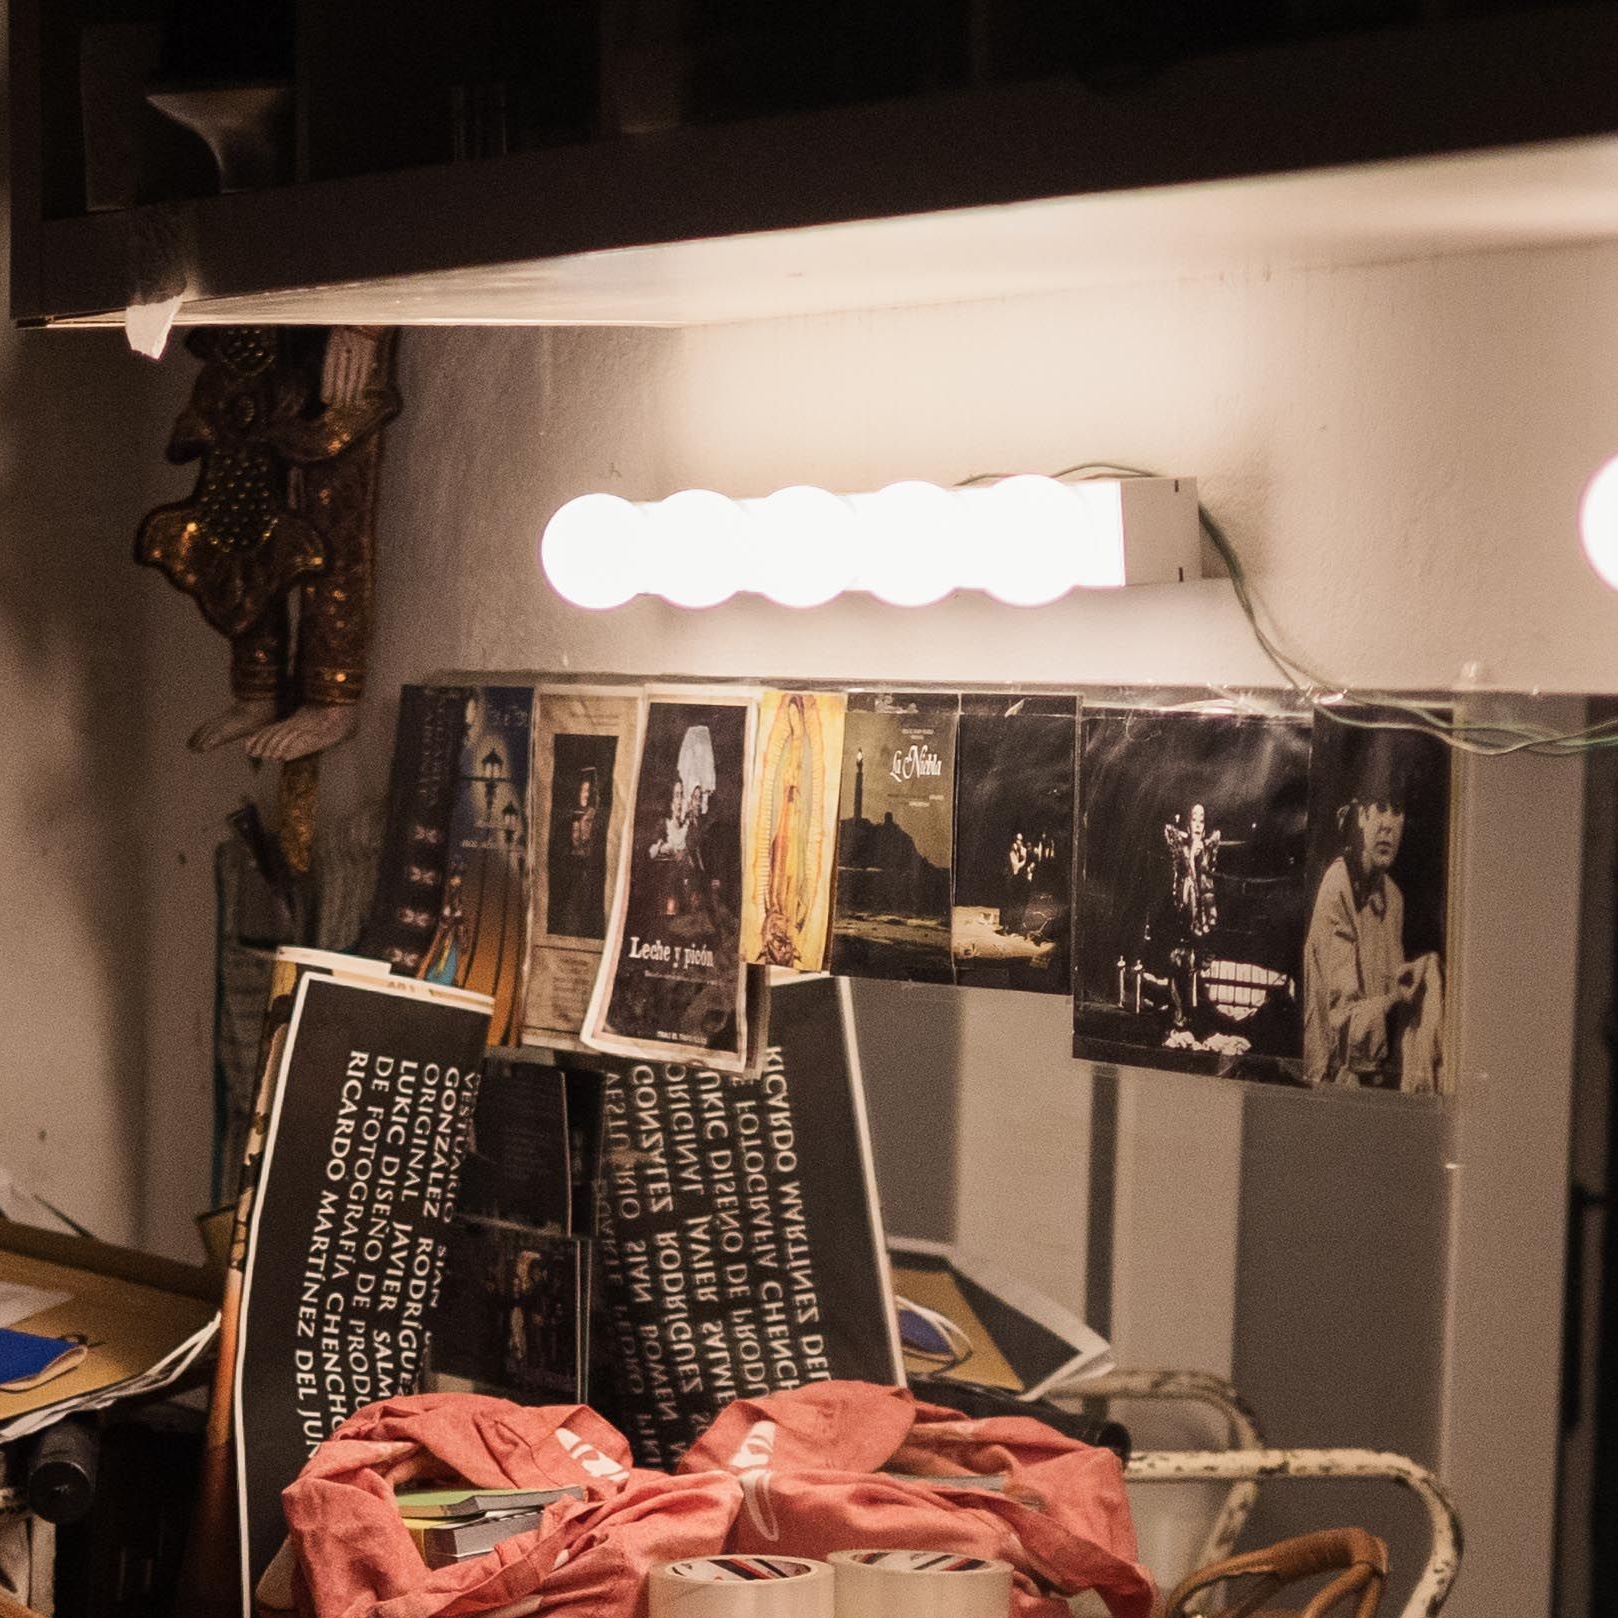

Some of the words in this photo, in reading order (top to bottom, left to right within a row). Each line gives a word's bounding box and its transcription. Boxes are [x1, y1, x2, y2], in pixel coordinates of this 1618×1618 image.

[628, 936, 671, 962] Leche
[672, 946, 682, 968] y
[683, 943, 715, 969] picón
[326, 1050, 370, 1181] RICARDO
[371, 1056, 395, 1092] DE
[387, 1060, 418, 1145] LUKIC
[401, 1063, 440, 1201] ORIGINAL
[423, 1067, 459, 1218] GONZÁLEZ
[331, 1105, 384, 1279] FOTOGRAFÍA
[364, 1156, 400, 1261] DISEÑO
[297, 1190, 339, 1338] MARTÍNEZ
[352, 1273, 376, 1308] DE
[378, 1221, 413, 1312] JAVIER
[295, 1350, 318, 1400] DEL
